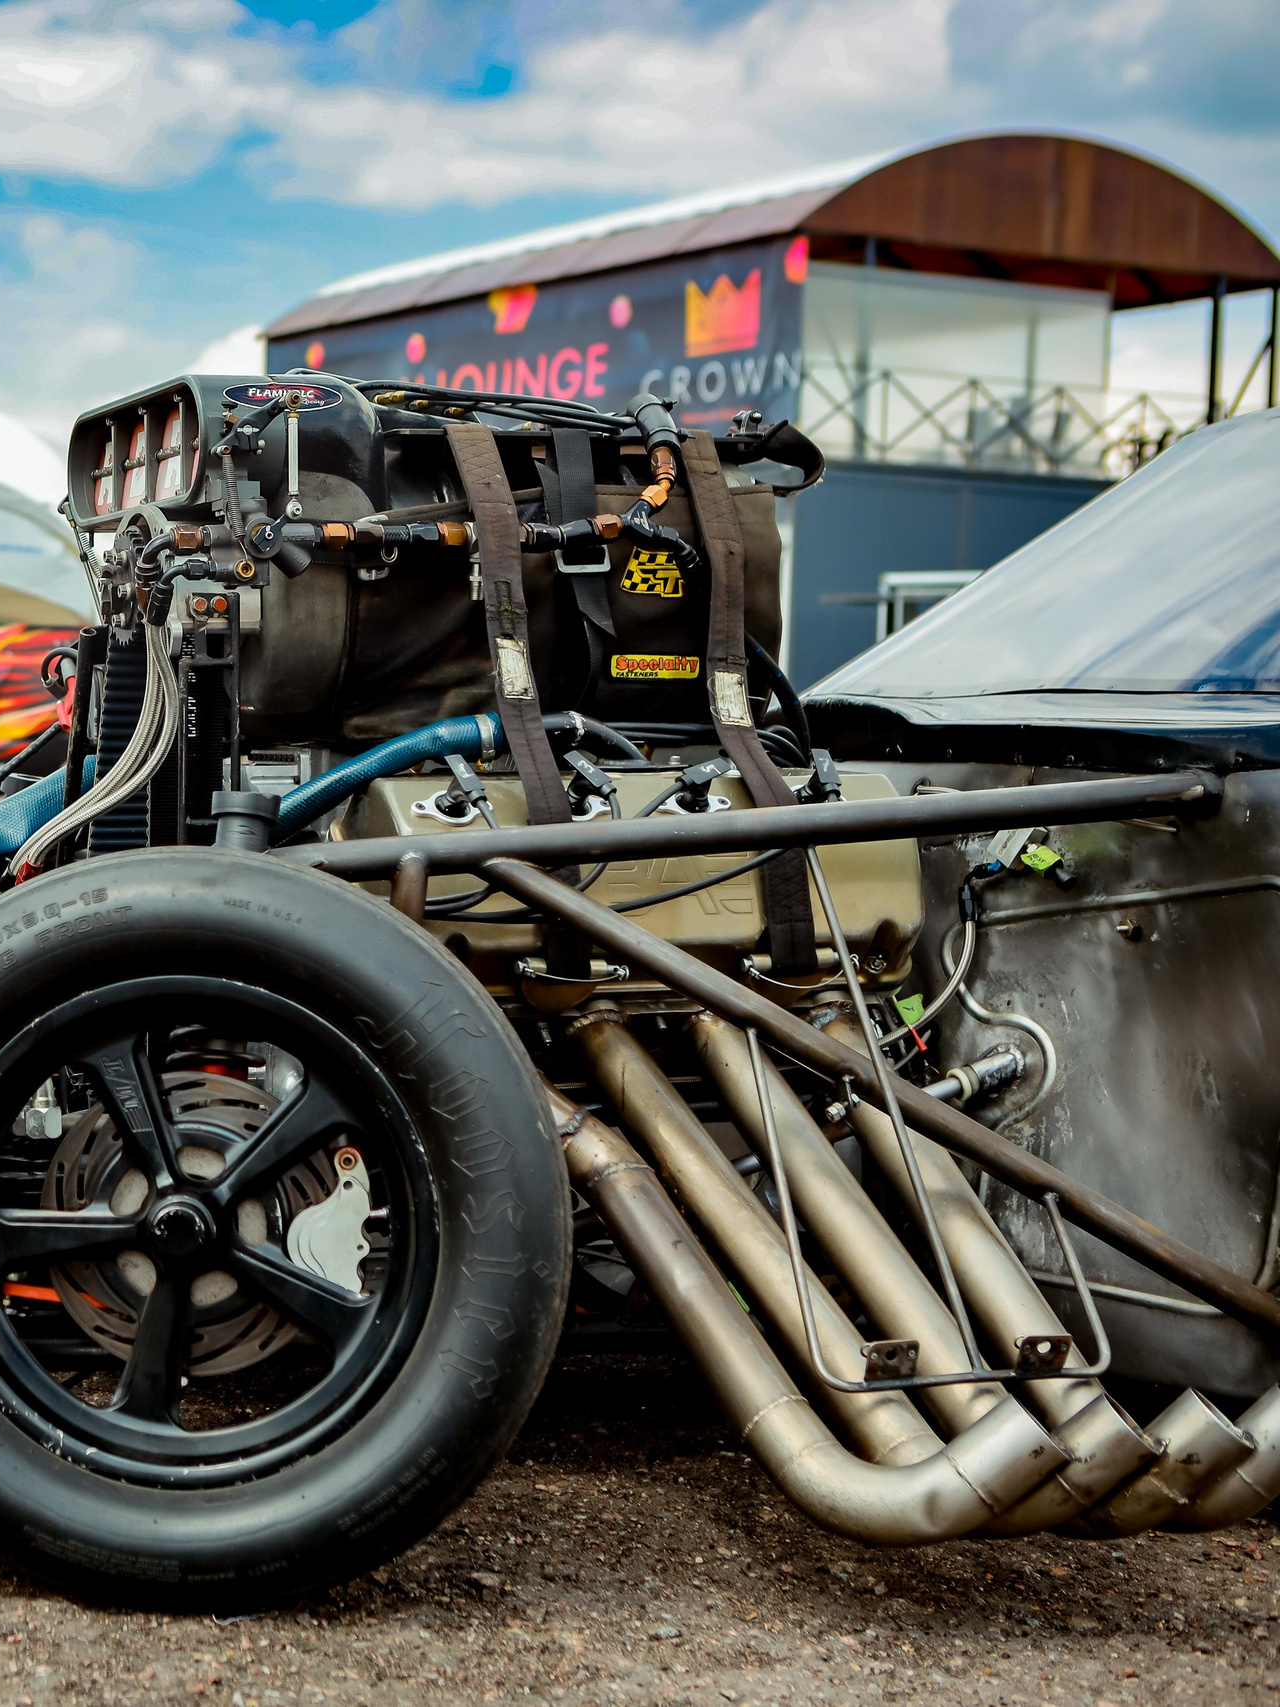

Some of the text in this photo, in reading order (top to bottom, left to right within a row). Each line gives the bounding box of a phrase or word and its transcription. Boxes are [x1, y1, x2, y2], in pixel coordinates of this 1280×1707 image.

[639, 350, 802, 402] CROWN
[615, 656, 699, 674] Specialty
[222, 898, 251, 911] MADE
[256, 904, 271, 915] IN
[34, 905, 132, 950] FRONT
